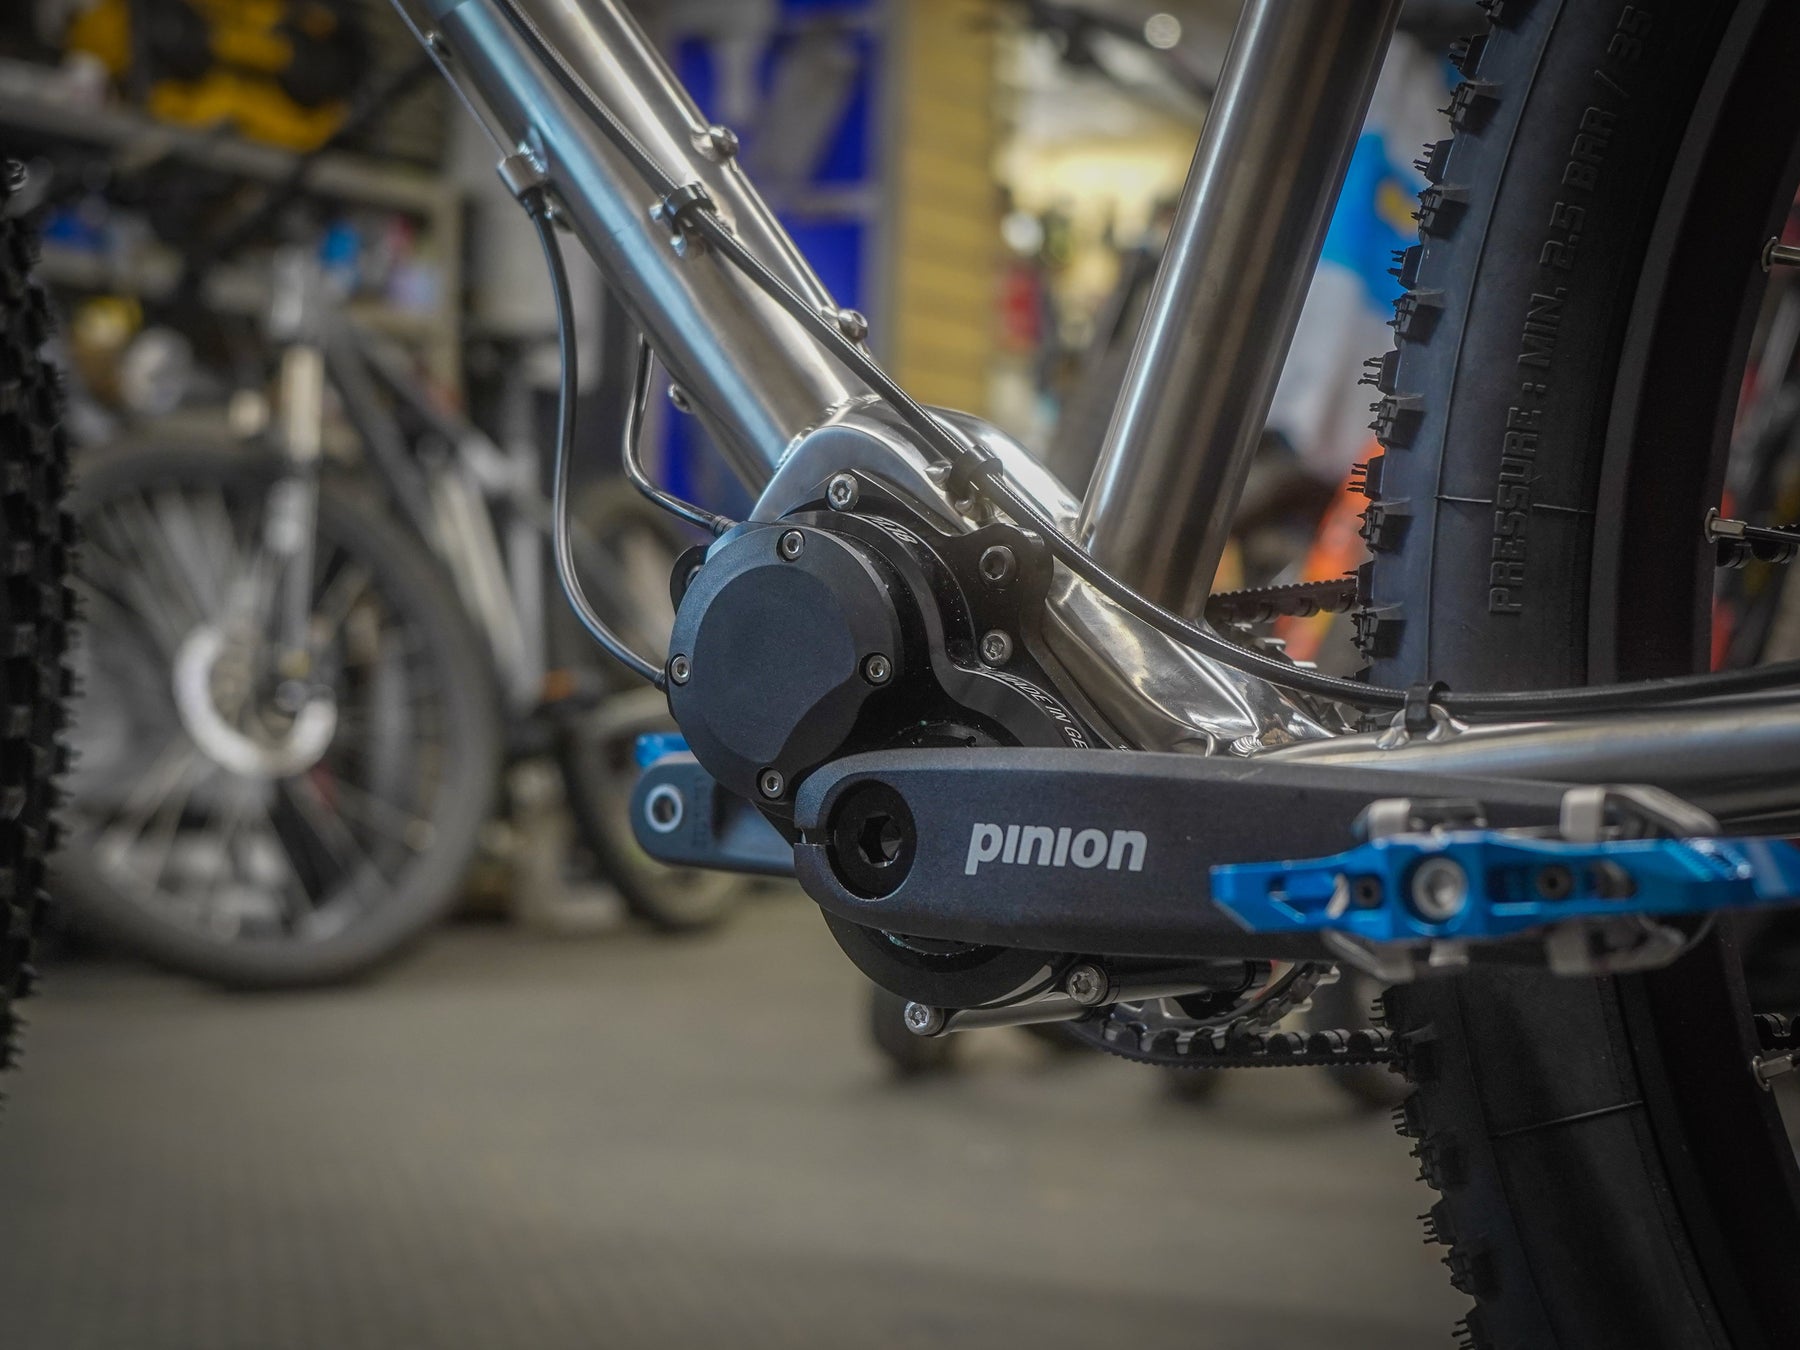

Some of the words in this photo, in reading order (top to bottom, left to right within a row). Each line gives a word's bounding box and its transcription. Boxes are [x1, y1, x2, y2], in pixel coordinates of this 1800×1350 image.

[1607, 4, 1653, 63] 35
[1561, 106, 1617, 193] BAR
[1539, 201, 1586, 271] 2.5
[1516, 286, 1568, 368] MIN.
[1488, 406, 1542, 614] PRESSURE
[1045, 705, 1072, 724] IN
[964, 822, 1148, 876] pinion
